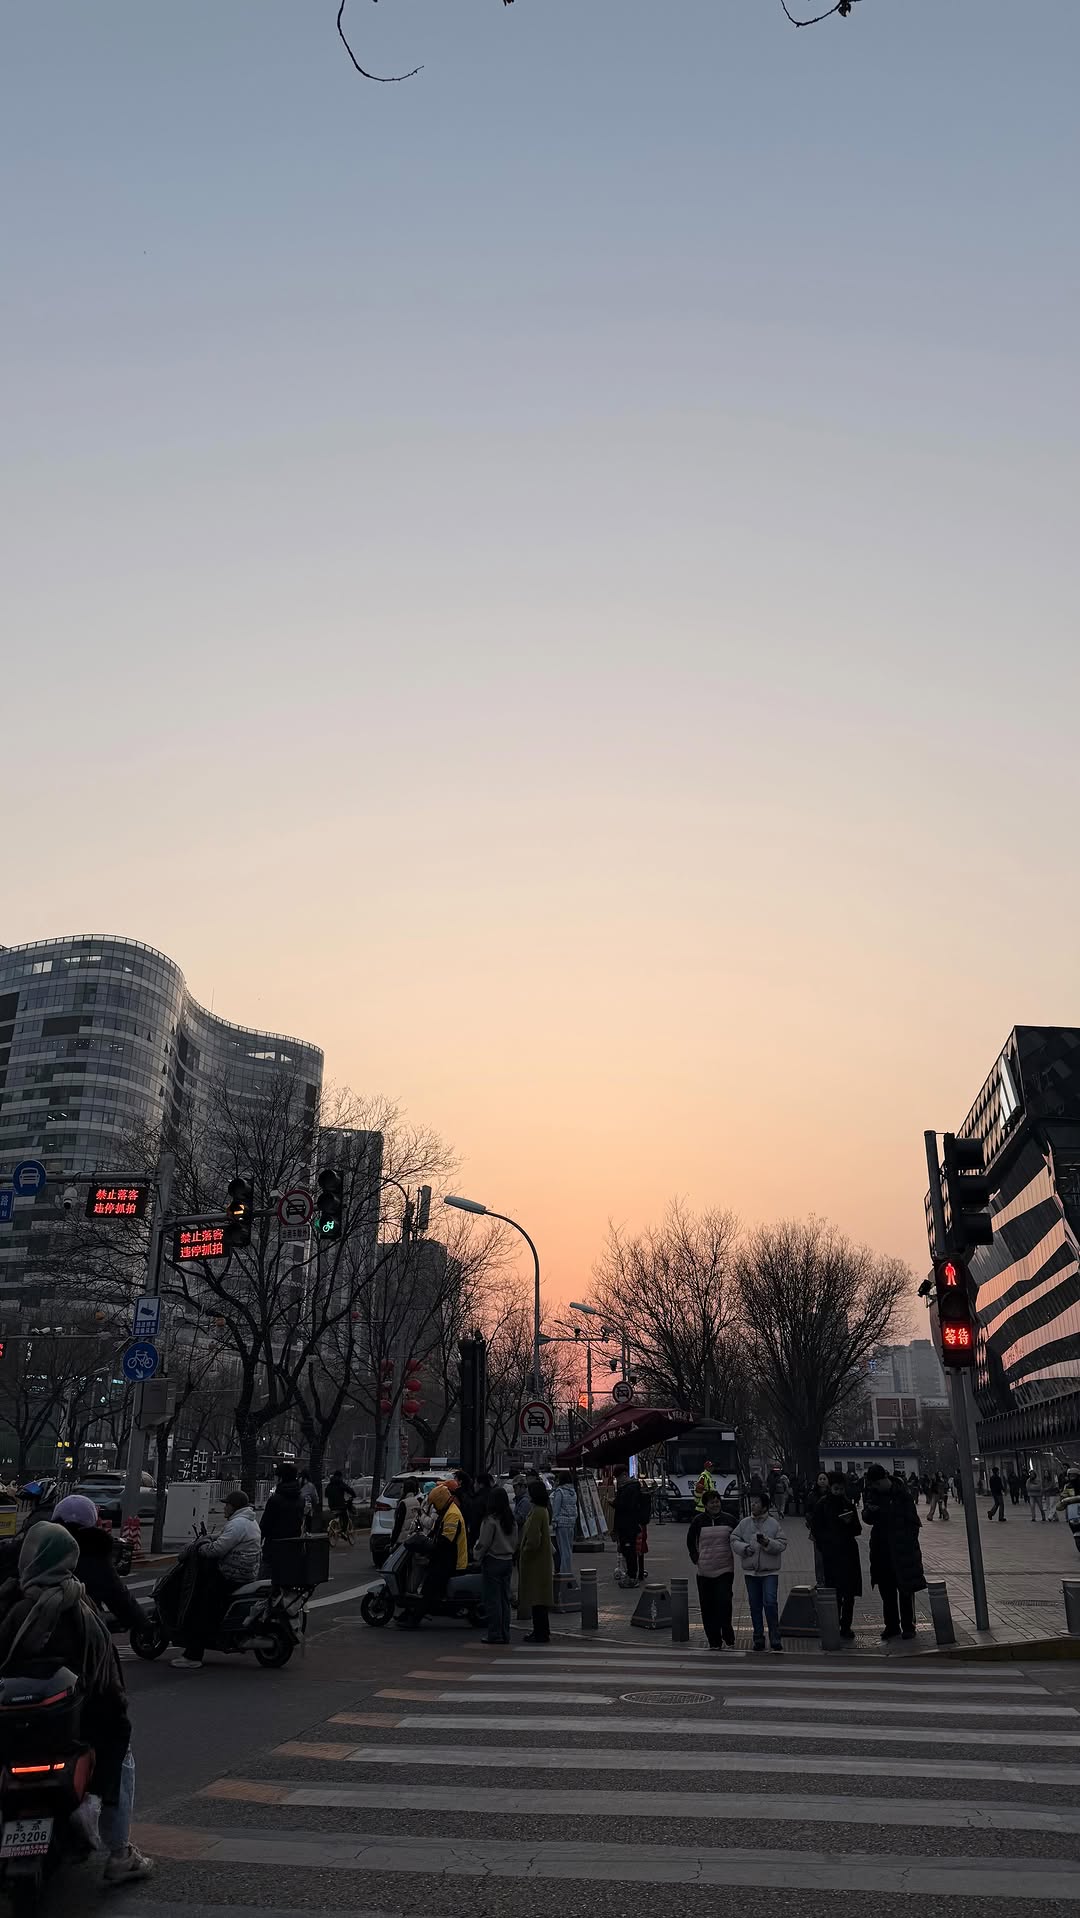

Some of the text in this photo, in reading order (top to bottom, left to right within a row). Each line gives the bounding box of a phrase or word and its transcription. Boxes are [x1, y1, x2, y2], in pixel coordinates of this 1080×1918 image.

[95, 1189, 139, 1201] 禁止落客
[93, 1202, 137, 1214] 违停抓拍
[180, 1228, 224, 1244] 禁止落客
[180, 1242, 223, 1258] 违停抓拍
[944, 1327, 969, 1345] 等待
[16, 1820, 42, 1832] 北京
[5, 1831, 47, 1844] PP3206
